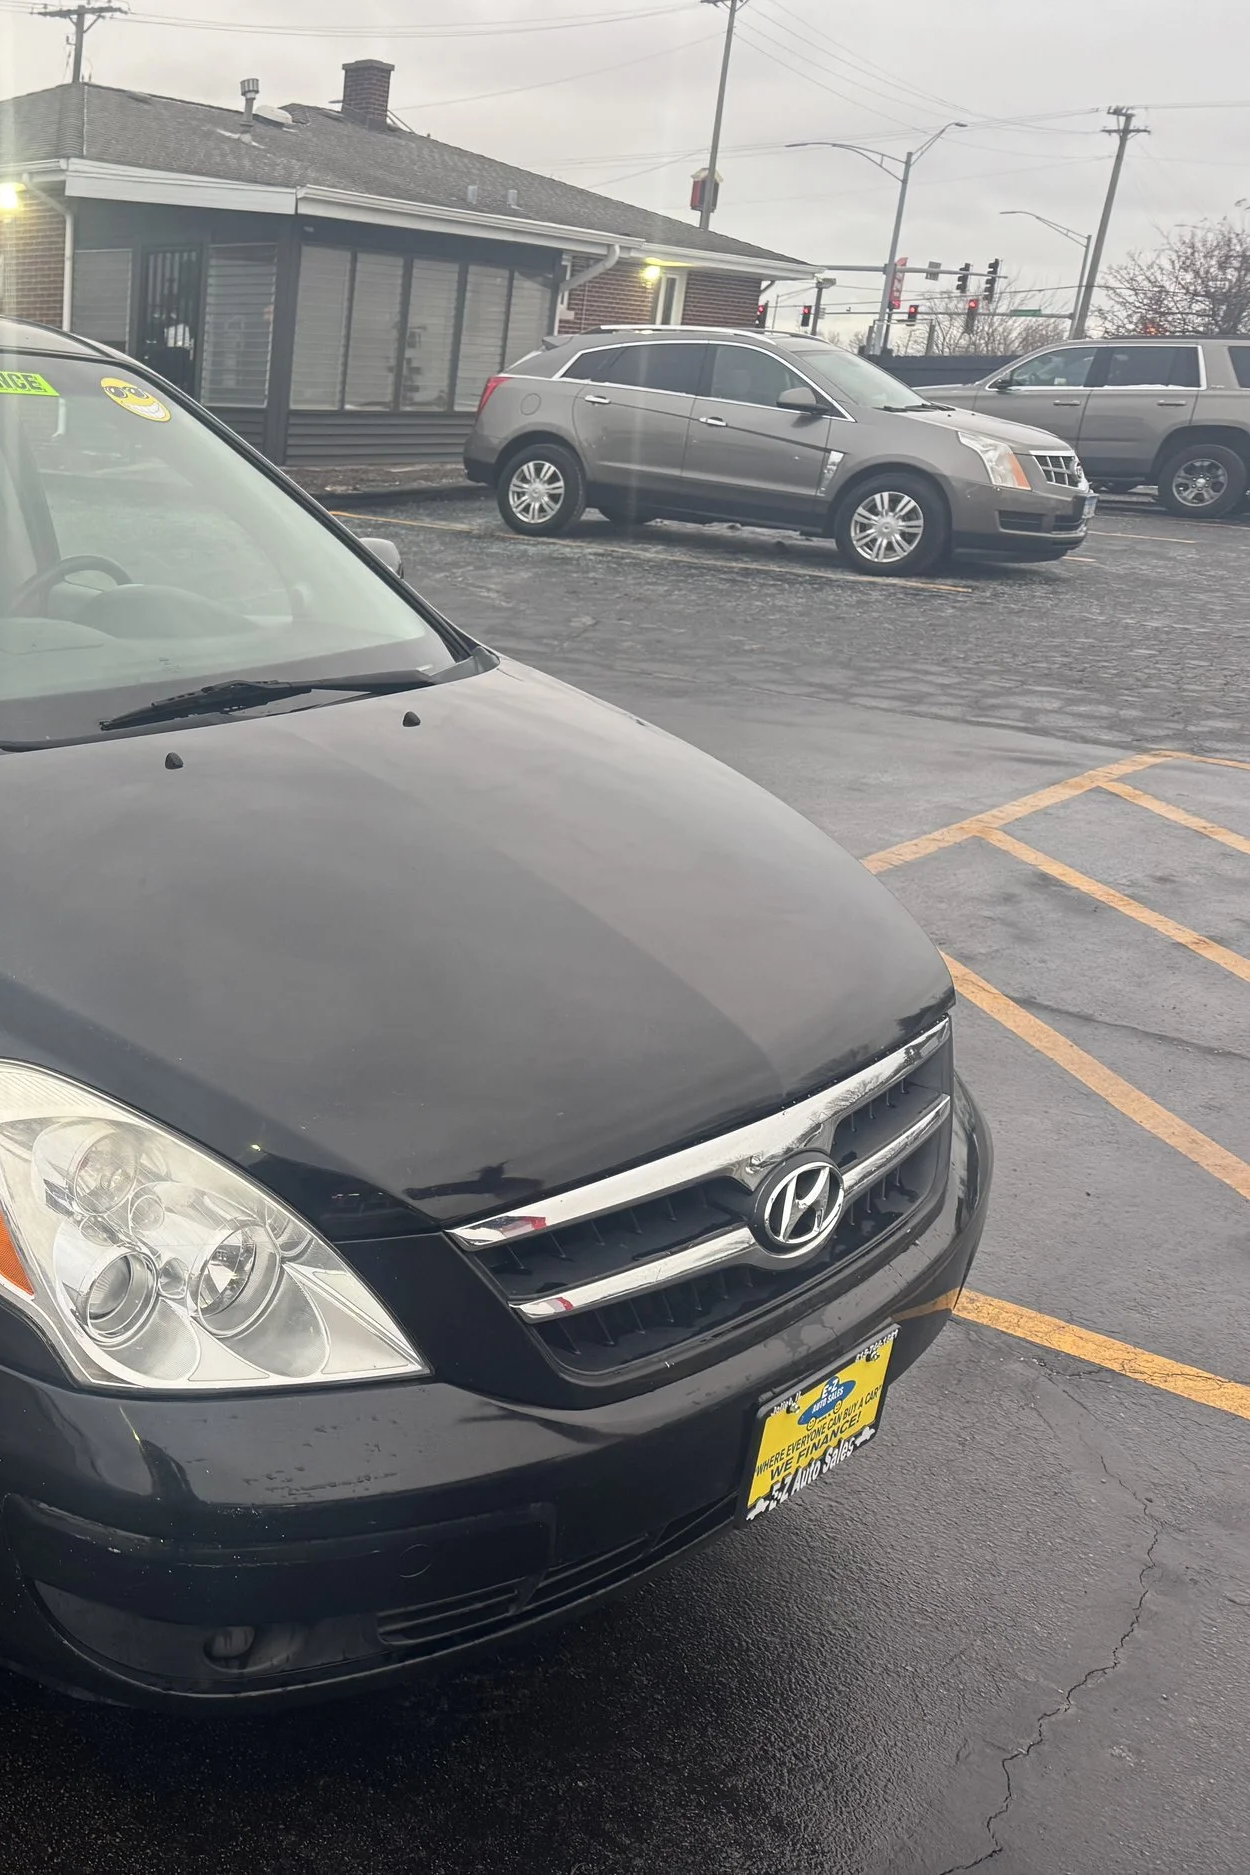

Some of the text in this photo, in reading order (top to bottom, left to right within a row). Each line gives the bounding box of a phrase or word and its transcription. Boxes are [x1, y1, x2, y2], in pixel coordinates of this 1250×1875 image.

[826, 1385, 844, 1406] SALES
[770, 1411, 862, 1481] WE FINANCE!
[786, 1424, 827, 1457] EVERYONE
[827, 1412, 843, 1431] CAN
[843, 1400, 859, 1420] BUY
[791, 1459, 821, 1497] Auto
[822, 1437, 855, 1474] Sales
